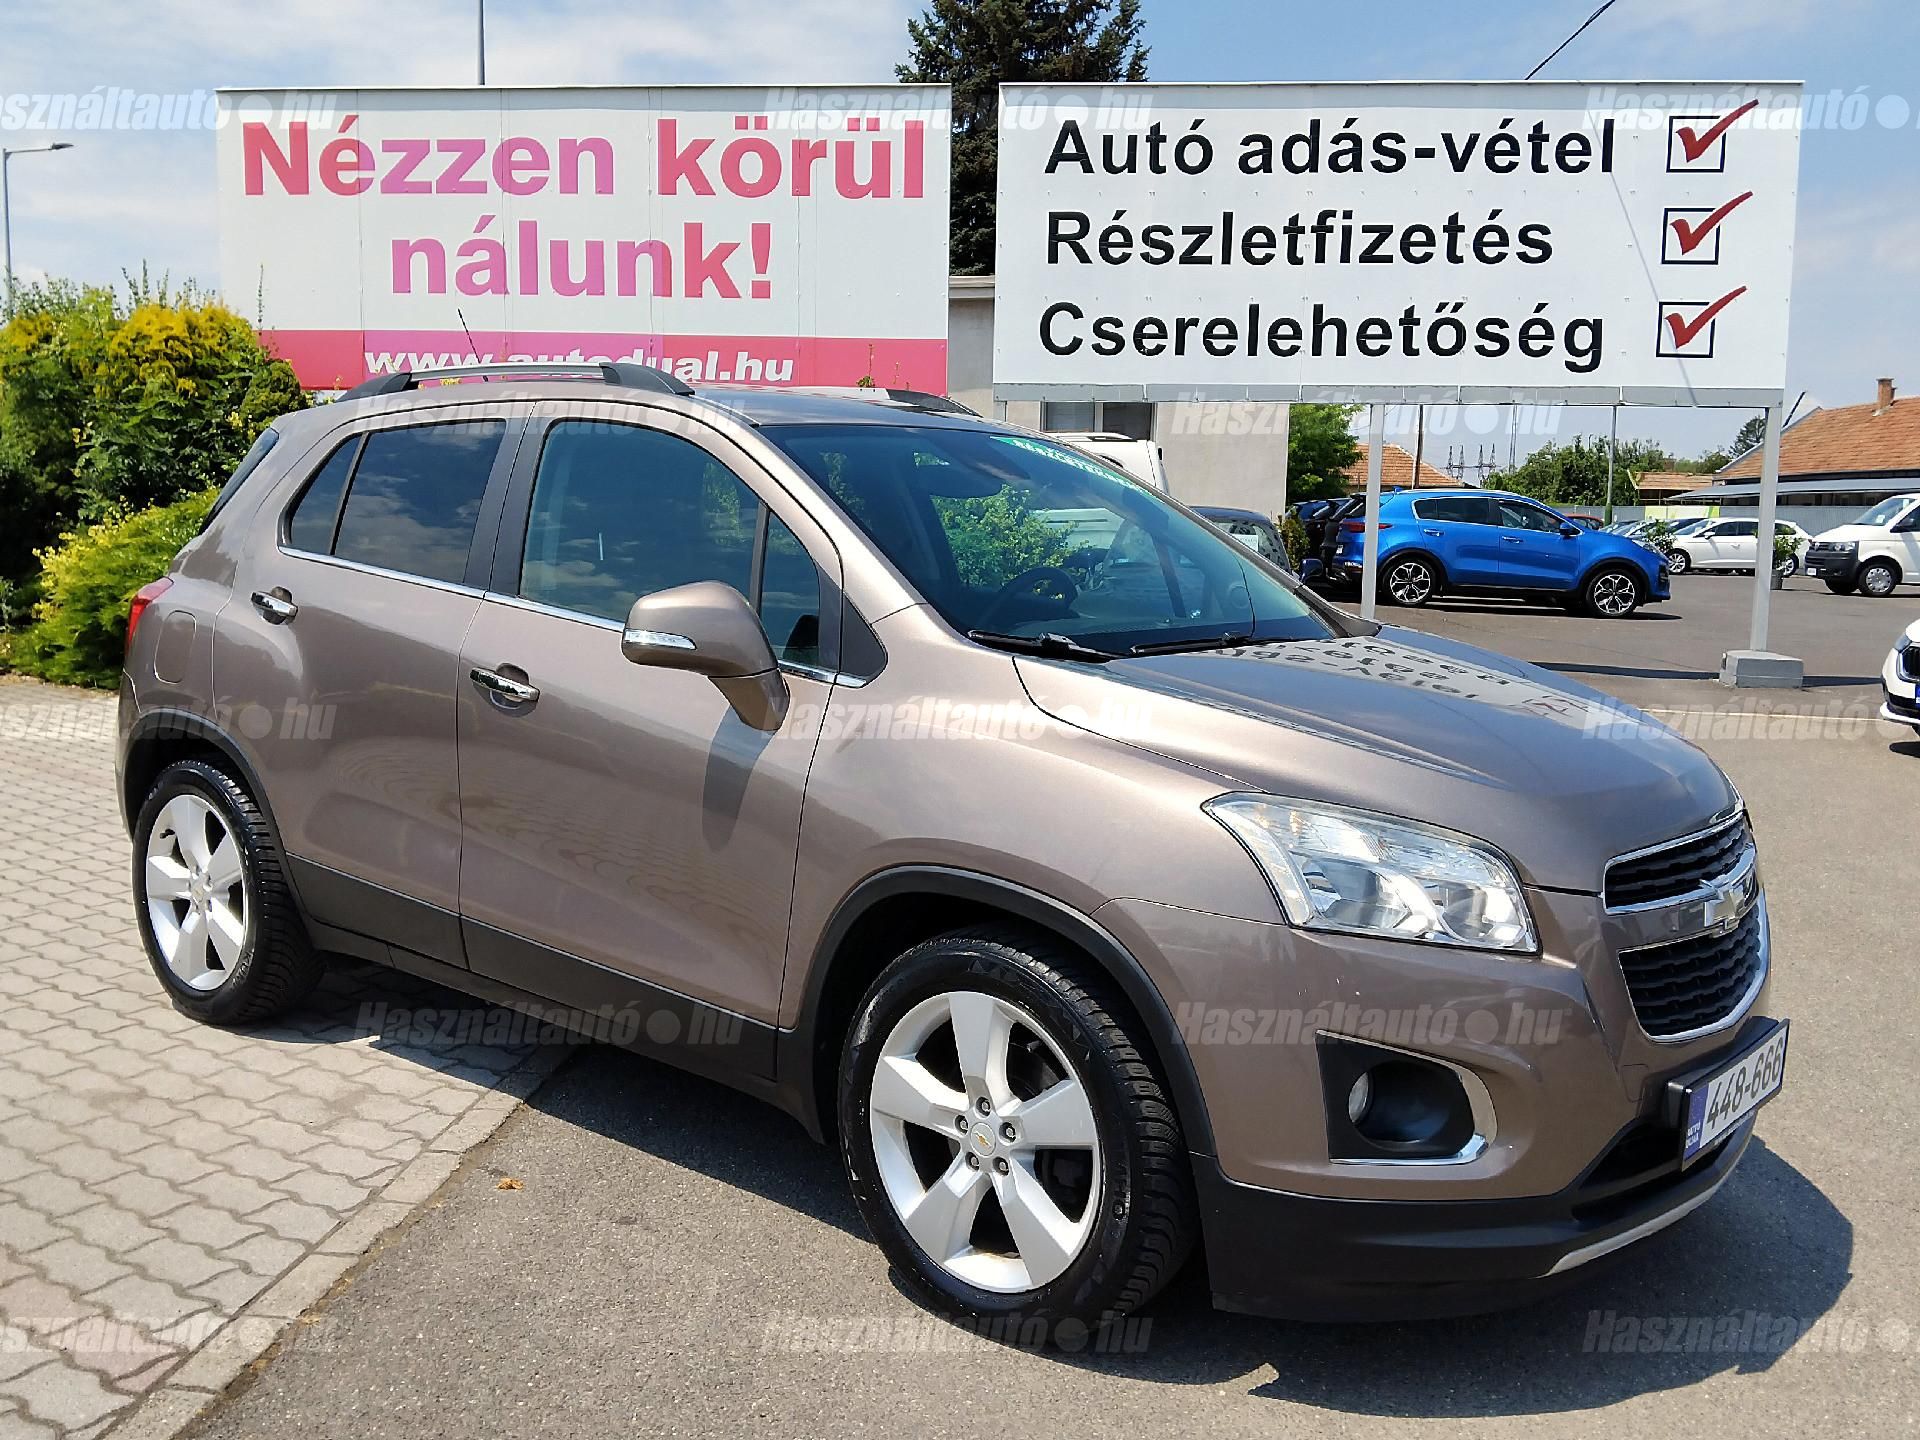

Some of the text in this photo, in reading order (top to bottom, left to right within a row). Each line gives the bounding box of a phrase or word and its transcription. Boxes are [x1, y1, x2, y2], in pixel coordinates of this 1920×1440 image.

[244, 114, 925, 199] Nézzen körül
[1044, 117, 1616, 175] Autó adás-vétel
[392, 215, 772, 298] nálunk!
[1047, 208, 1554, 266] Részletfizetés
[365, 348, 795, 382] wwwdual.hu
[1039, 301, 1604, 374] Cserelehetőség
